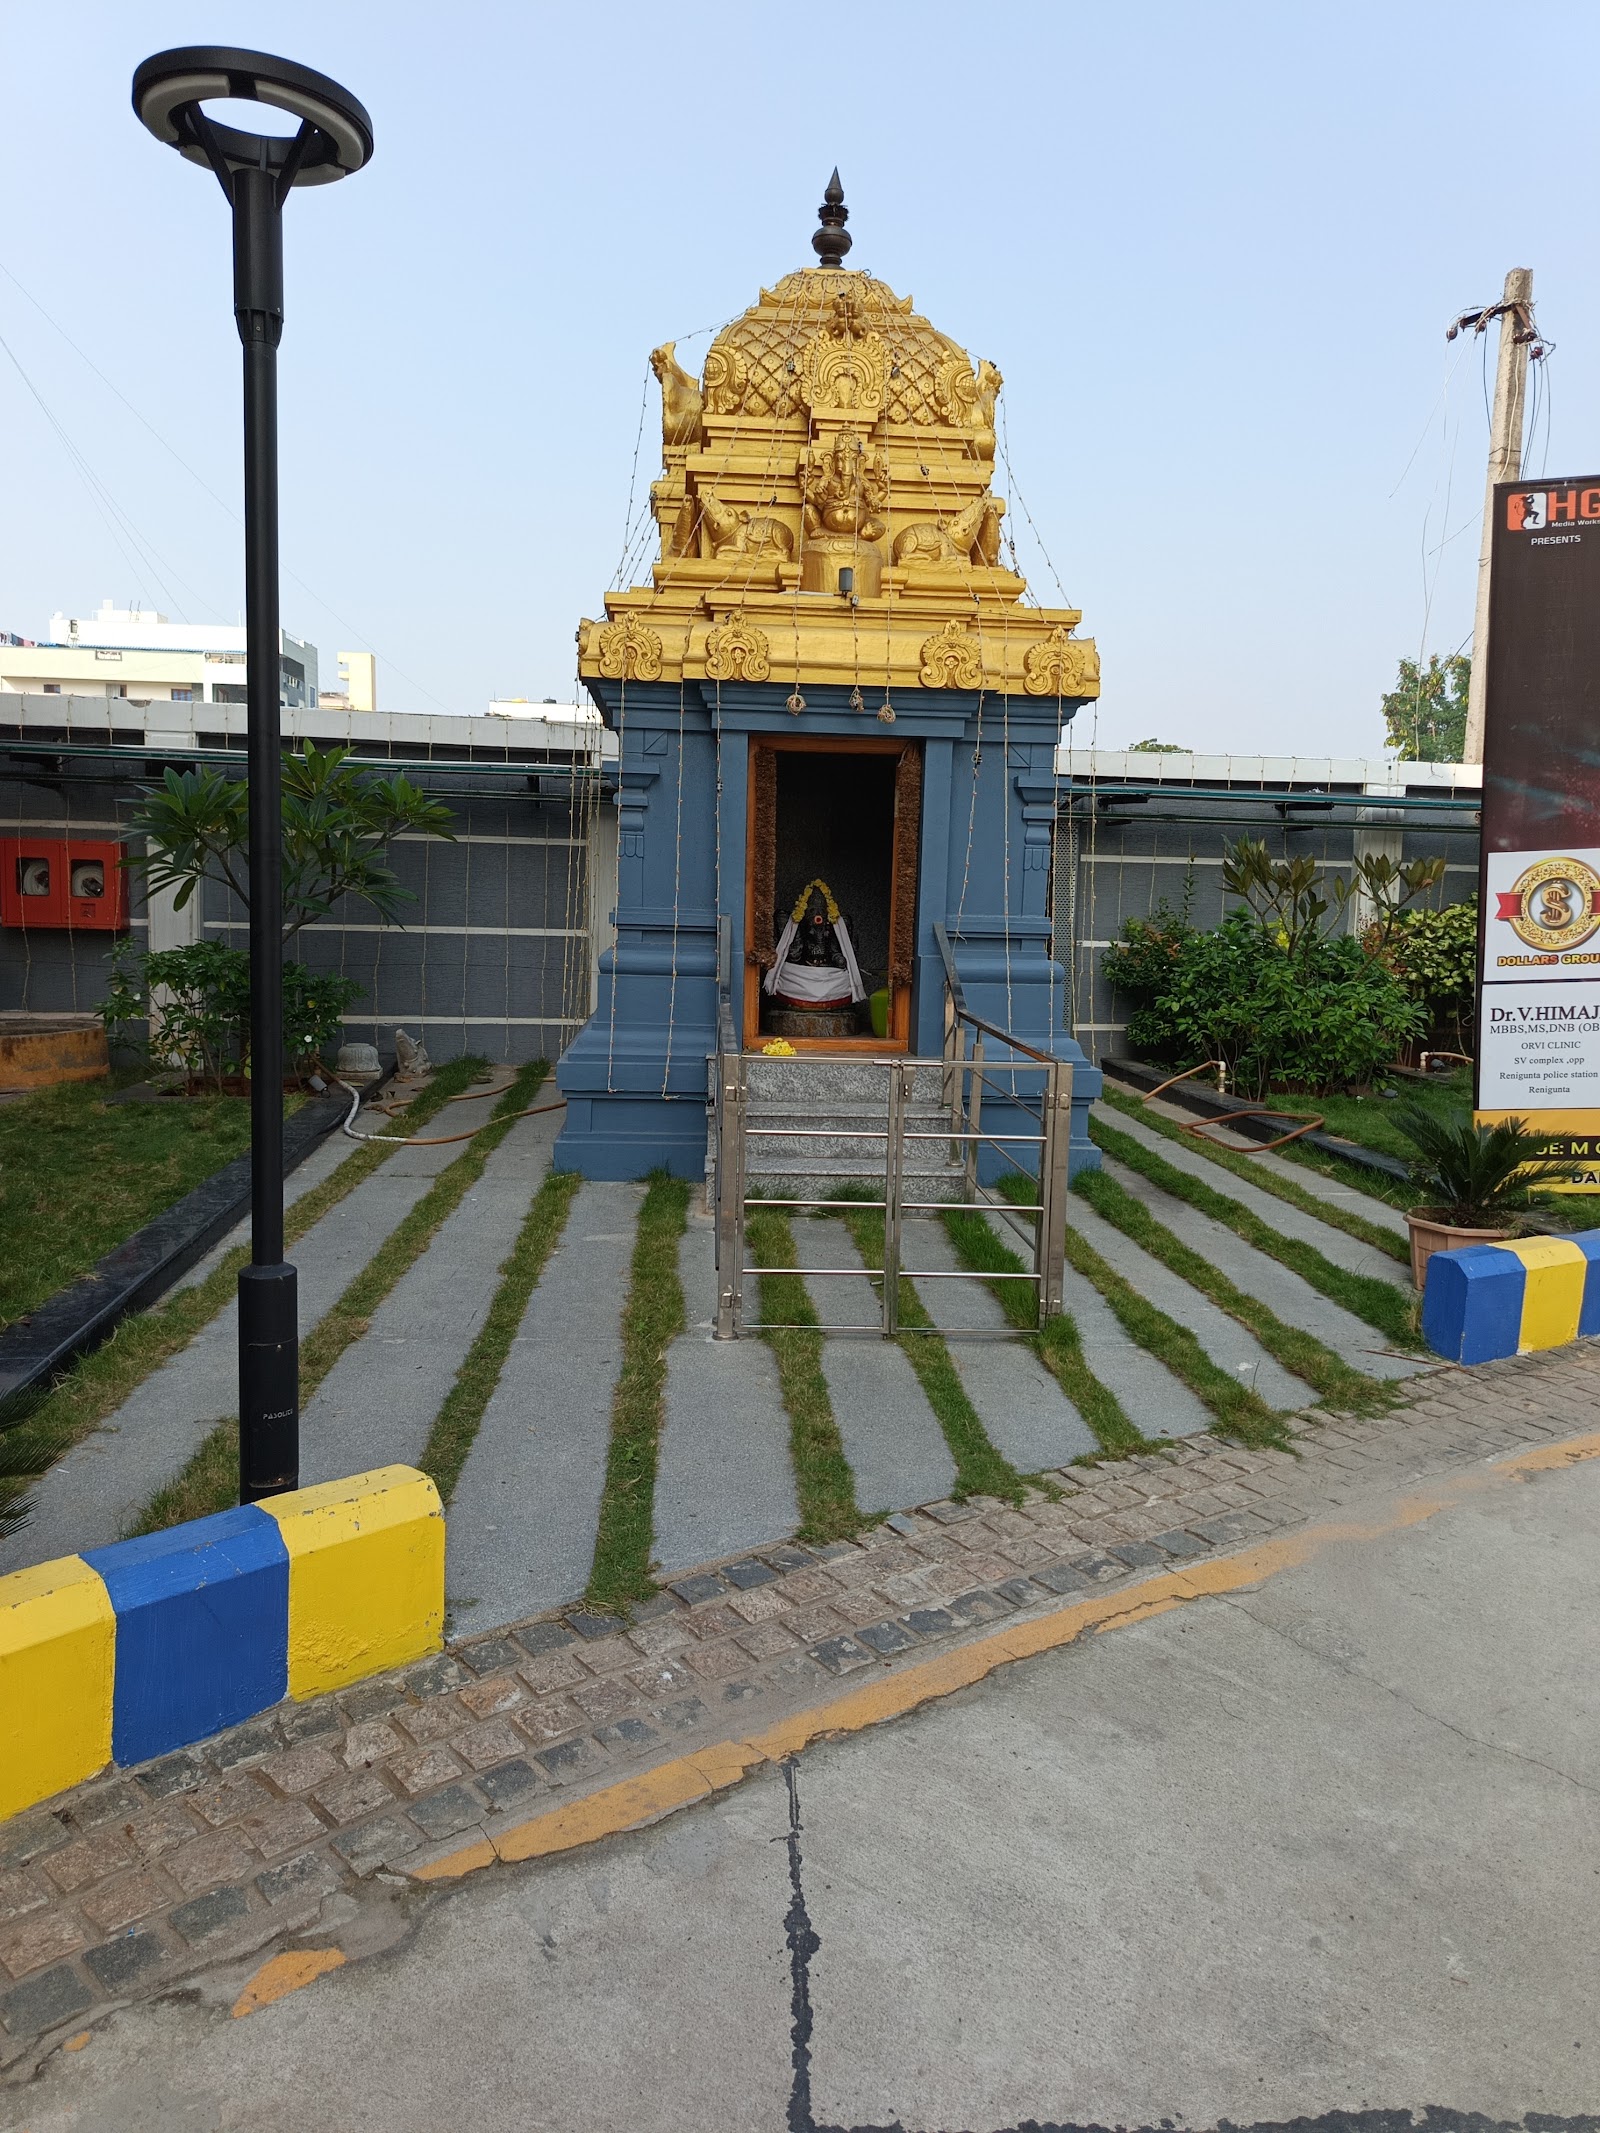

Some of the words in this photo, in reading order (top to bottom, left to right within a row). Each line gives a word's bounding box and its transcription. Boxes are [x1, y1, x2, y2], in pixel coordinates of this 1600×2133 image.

[1551, 520, 1575, 528] Media
[1530, 535, 1581, 546] PRESENTS
[1497, 954, 1559, 967] DOLLARS
[1490, 1005, 1600, 1022] Dr.V.HIMAJ
[1490, 1023, 1575, 1034] MBBS,MS,DNB
[1578, 1022, 1600, 1034] (OB
[1521, 1042, 1545, 1050] ORVI
[1547, 1041, 1581, 1049] CLINIC
[1514, 1057, 1527, 1065] SV
[1529, 1056, 1564, 1066] complex
[1499, 1071, 1541, 1081] Renigunta
[1543, 1070, 1568, 1081] police
[1570, 1070, 1599, 1079] station
[1528, 1086, 1571, 1095] Renigunta
[1570, 1141, 1589, 1155] M
[1571, 1170, 1600, 1184] DA
